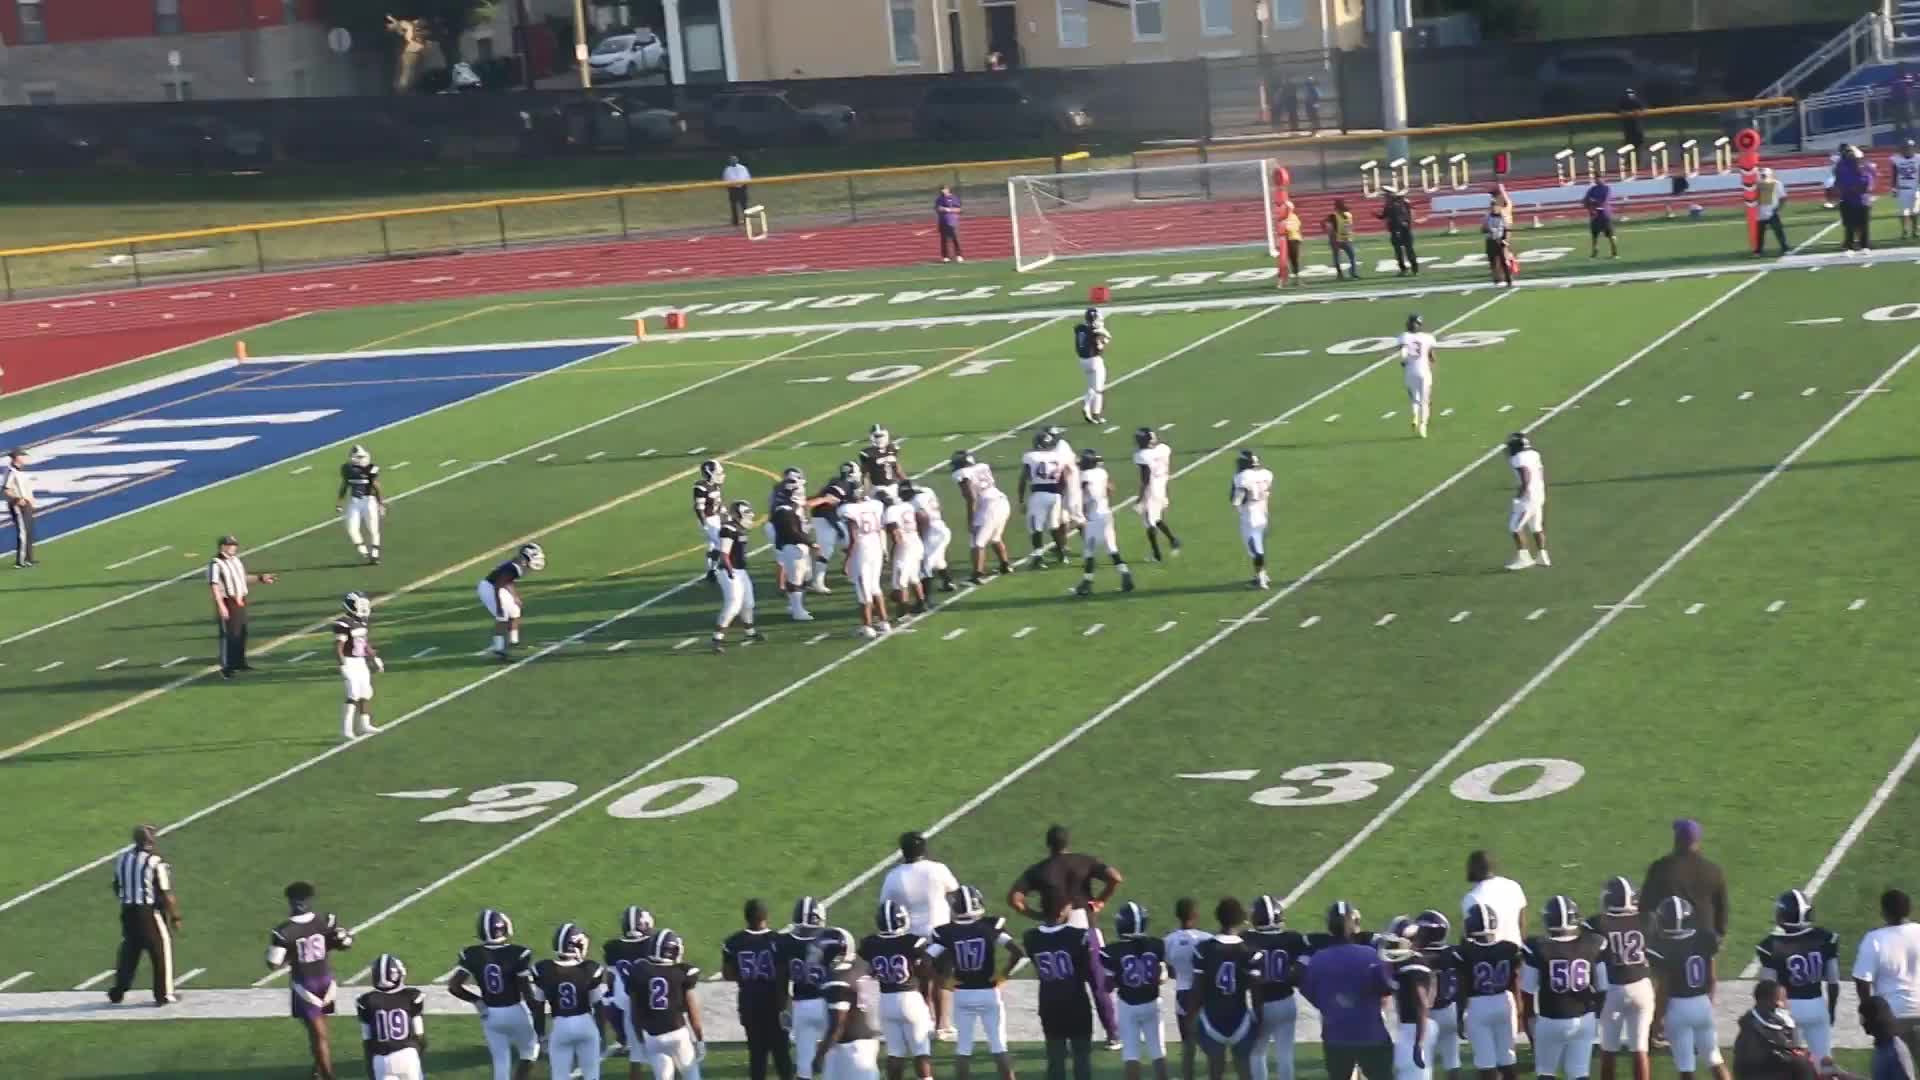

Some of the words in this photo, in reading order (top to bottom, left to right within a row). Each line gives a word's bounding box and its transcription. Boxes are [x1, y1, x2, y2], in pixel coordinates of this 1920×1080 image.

[417, 775, 740, 823] 20
[1248, 757, 1586, 807] 30
[483, 963, 504, 994] 6
[1215, 960, 1237, 995] 4
[1549, 959, 1592, 993] 56
[1685, 954, 1707, 989] 0
[647, 976, 670, 1010] 2
[374, 1008, 410, 1043] 19
